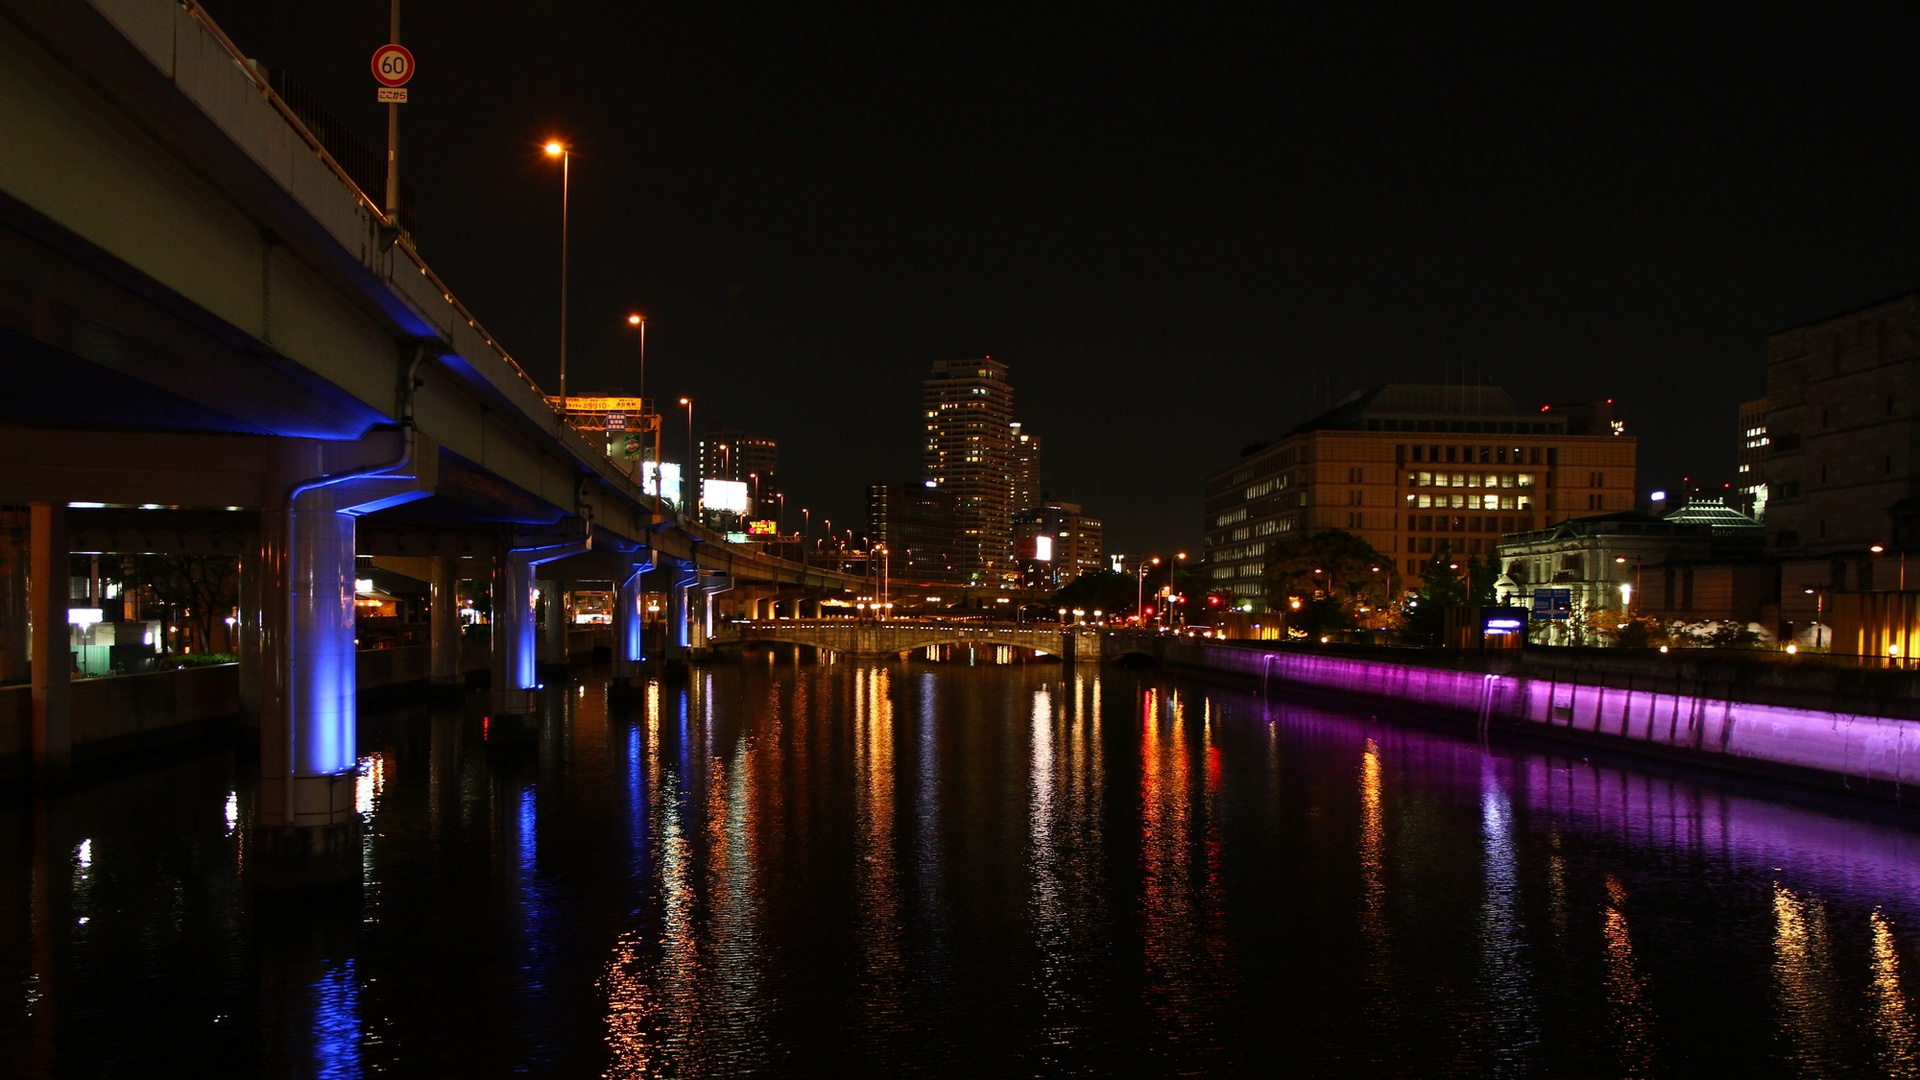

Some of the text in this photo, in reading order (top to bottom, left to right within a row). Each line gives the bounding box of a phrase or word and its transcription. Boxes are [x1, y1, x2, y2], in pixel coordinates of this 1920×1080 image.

[382, 56, 404, 74] 60
[379, 90, 406, 100] ここから
